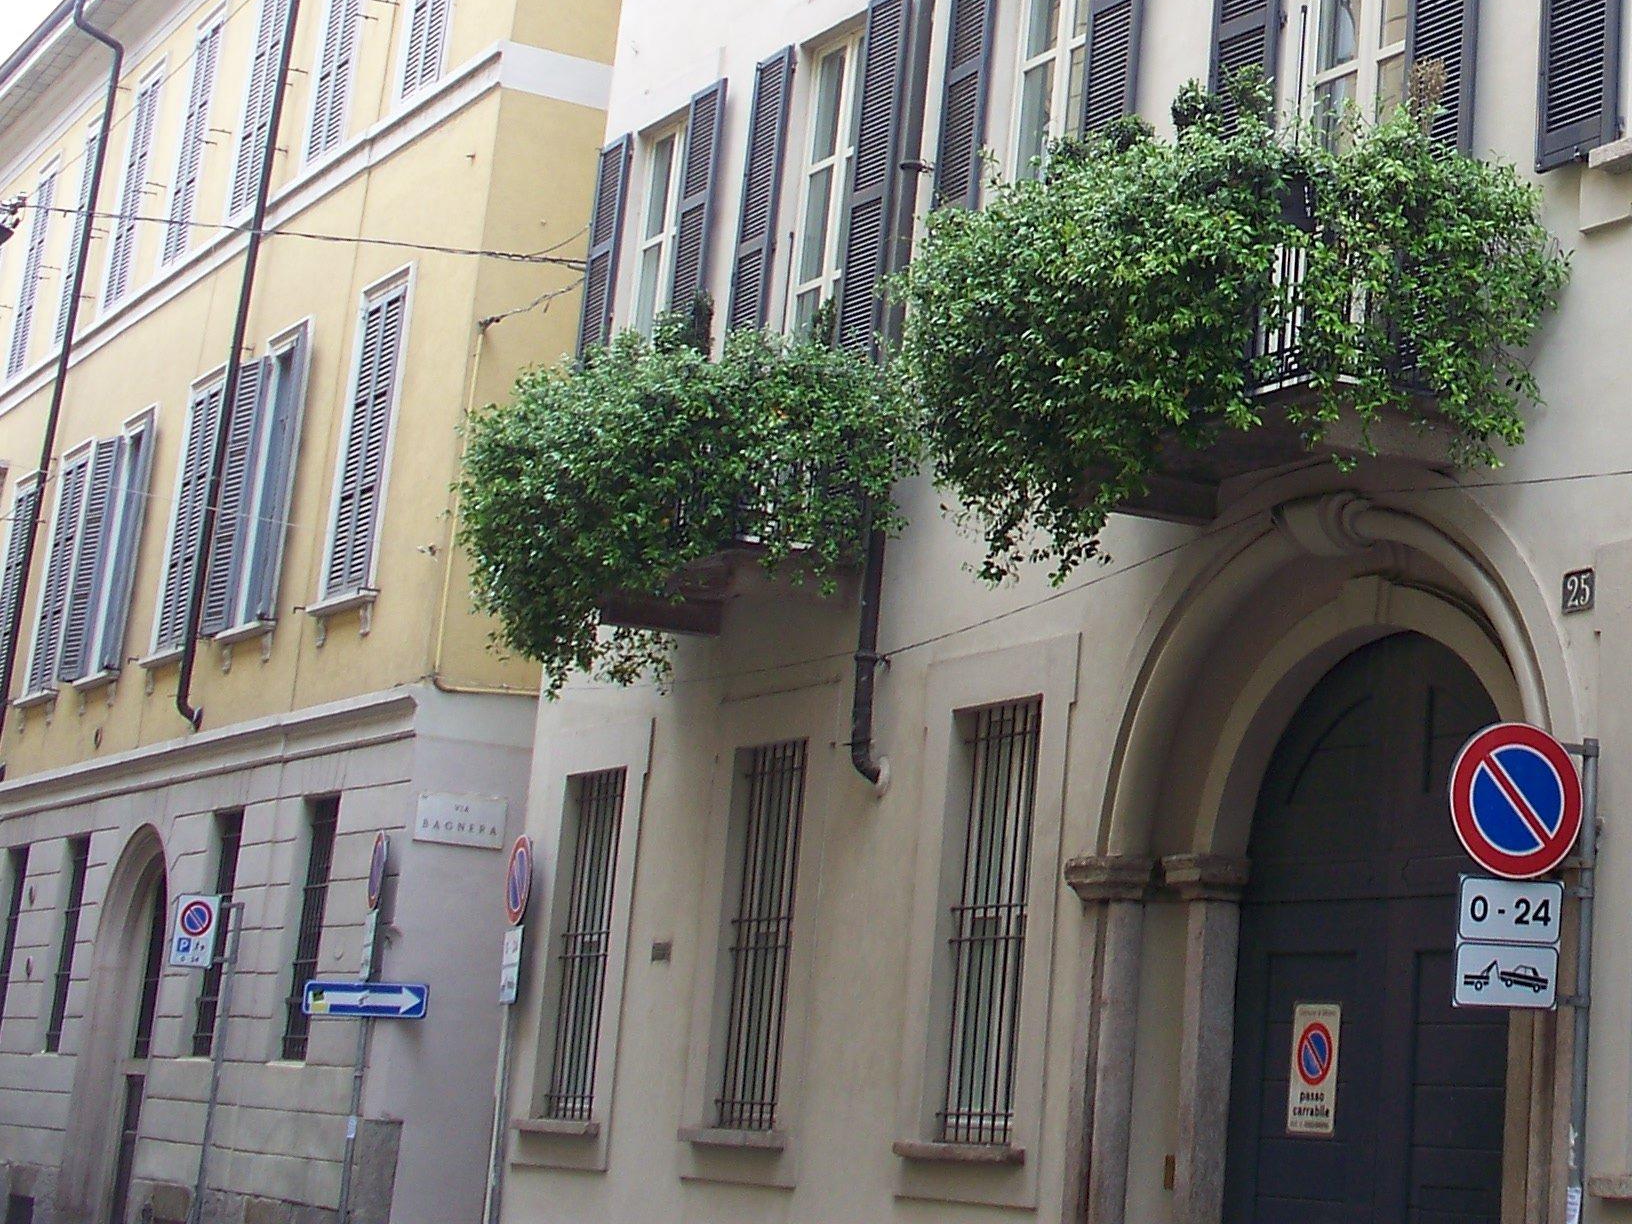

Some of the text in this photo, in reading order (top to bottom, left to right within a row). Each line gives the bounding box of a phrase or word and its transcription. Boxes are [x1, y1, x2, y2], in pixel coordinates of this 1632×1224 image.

[1567, 573, 1590, 607] 25
[422, 818, 497, 836] BAGNERA
[1470, 895, 1489, 922] 0
[1514, 897, 1552, 927] 24
[1300, 1091, 1325, 1103] passo
[1293, 1105, 1330, 1118] carrabile
